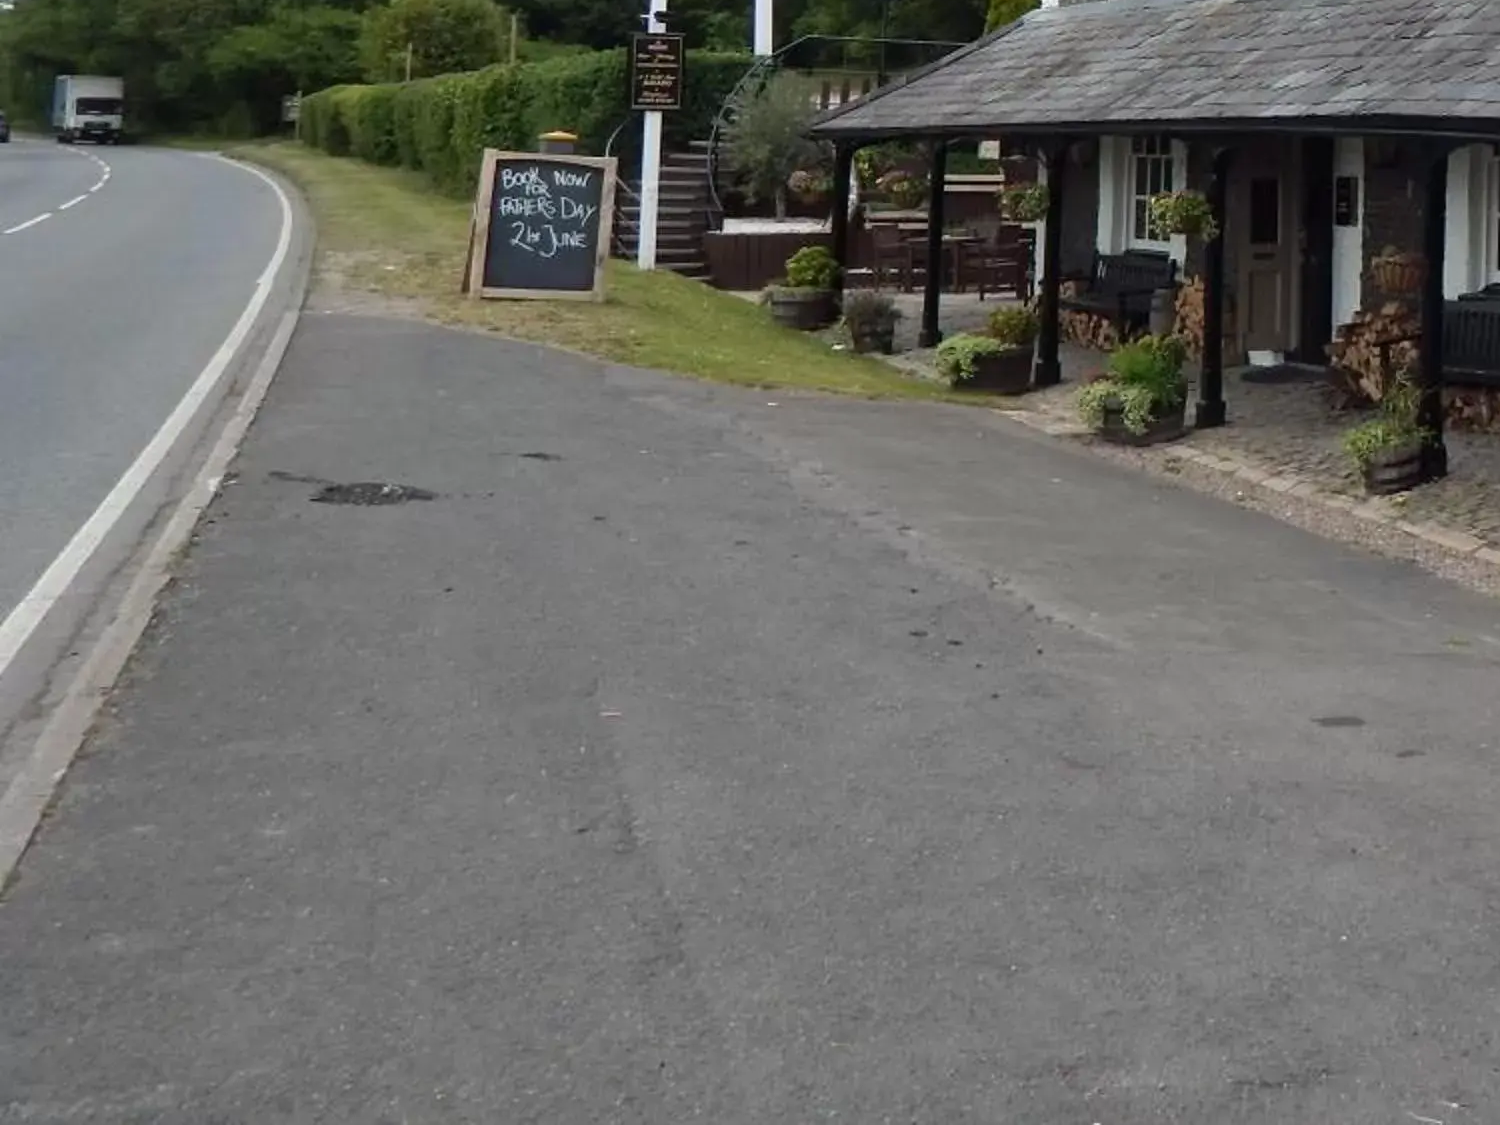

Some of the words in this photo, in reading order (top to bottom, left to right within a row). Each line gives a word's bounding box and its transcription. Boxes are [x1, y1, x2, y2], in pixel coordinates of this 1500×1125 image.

[554, 170, 592, 187] NOW
[525, 184, 552, 198] FOR
[560, 196, 597, 227] DAY
[539, 224, 588, 258] JUNE
